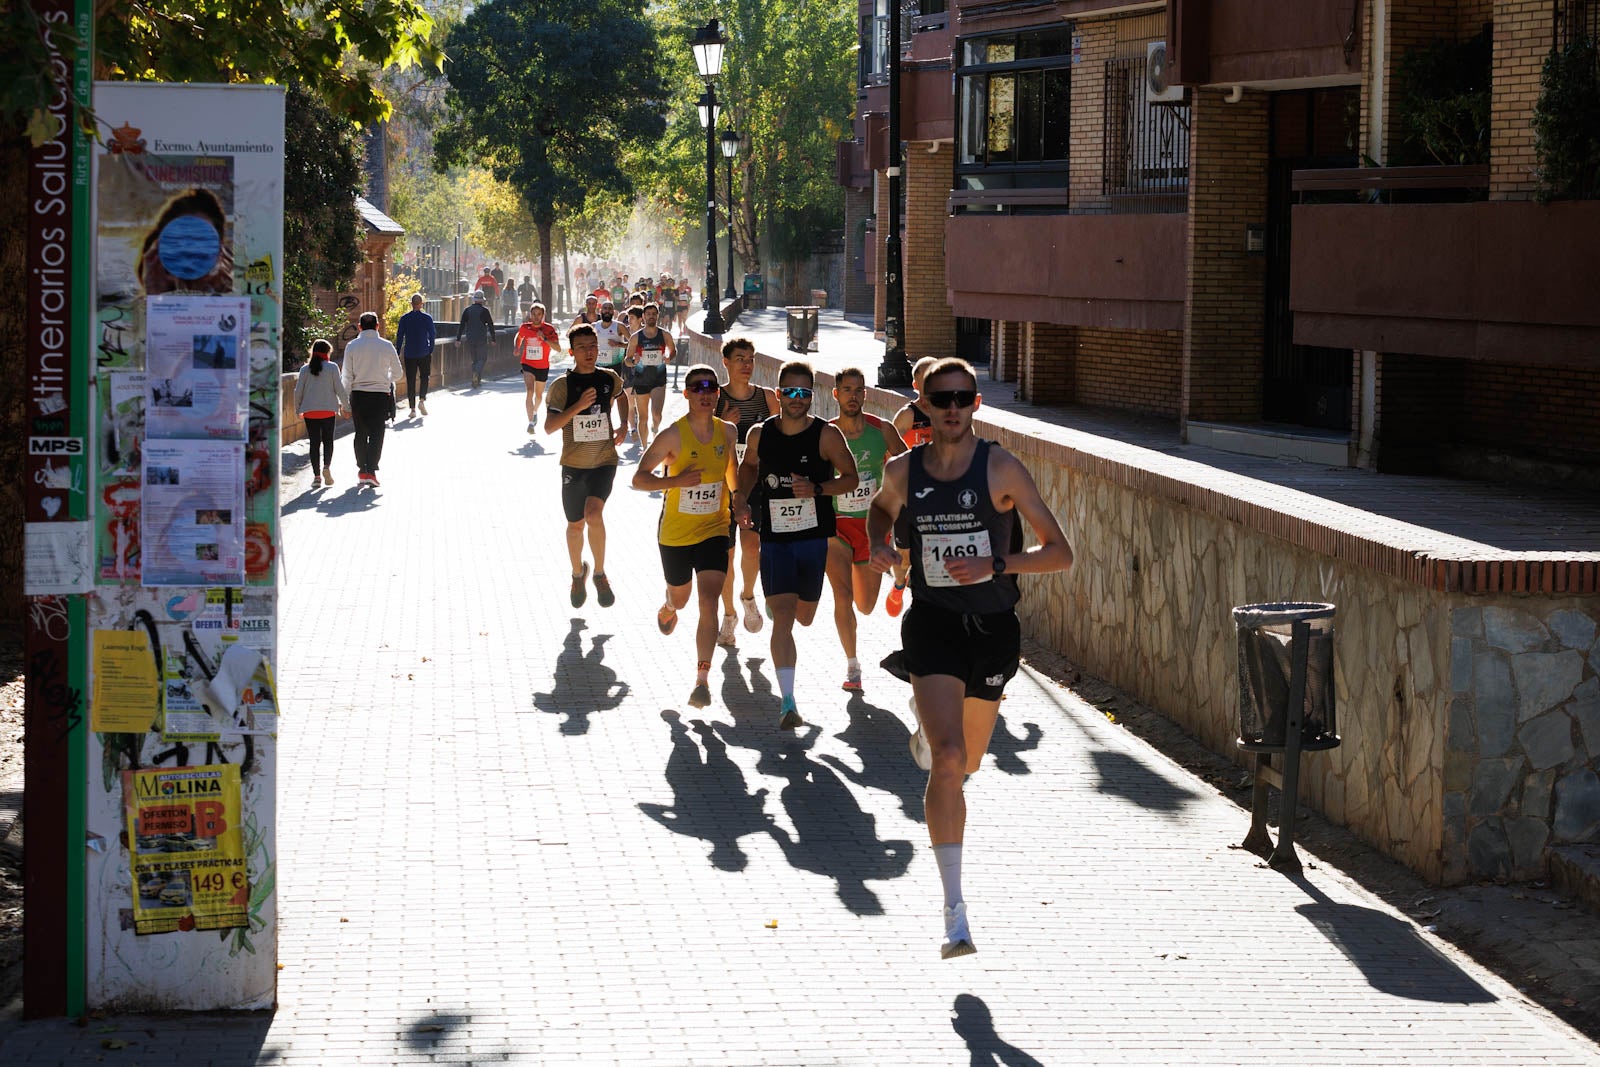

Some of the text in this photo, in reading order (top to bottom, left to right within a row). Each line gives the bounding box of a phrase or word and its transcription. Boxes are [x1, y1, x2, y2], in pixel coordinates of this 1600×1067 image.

[77, 58, 88, 72] la
[77, 80, 88, 95] de
[154, 140, 274, 156] Excmo. Ayuntamiento
[76, 156, 87, 185] Ruta
[579, 419, 602, 429] 1497
[31, 440, 81, 453] MPS
[687, 489, 716, 501] 1154
[780, 505, 803, 517] 257
[916, 513, 975, 523] CLUB ATLETISMO
[931, 544, 978, 562] 1469
[195, 620, 223, 629] OFERTA
[159, 771, 222, 781] AUTOESCUELAS
[140, 775, 221, 796] MOLINA
[195, 800, 227, 837] B
[143, 820, 188, 831] PERMISO
[164, 861, 195, 871] CLASES
[193, 871, 245, 892] 149 €
